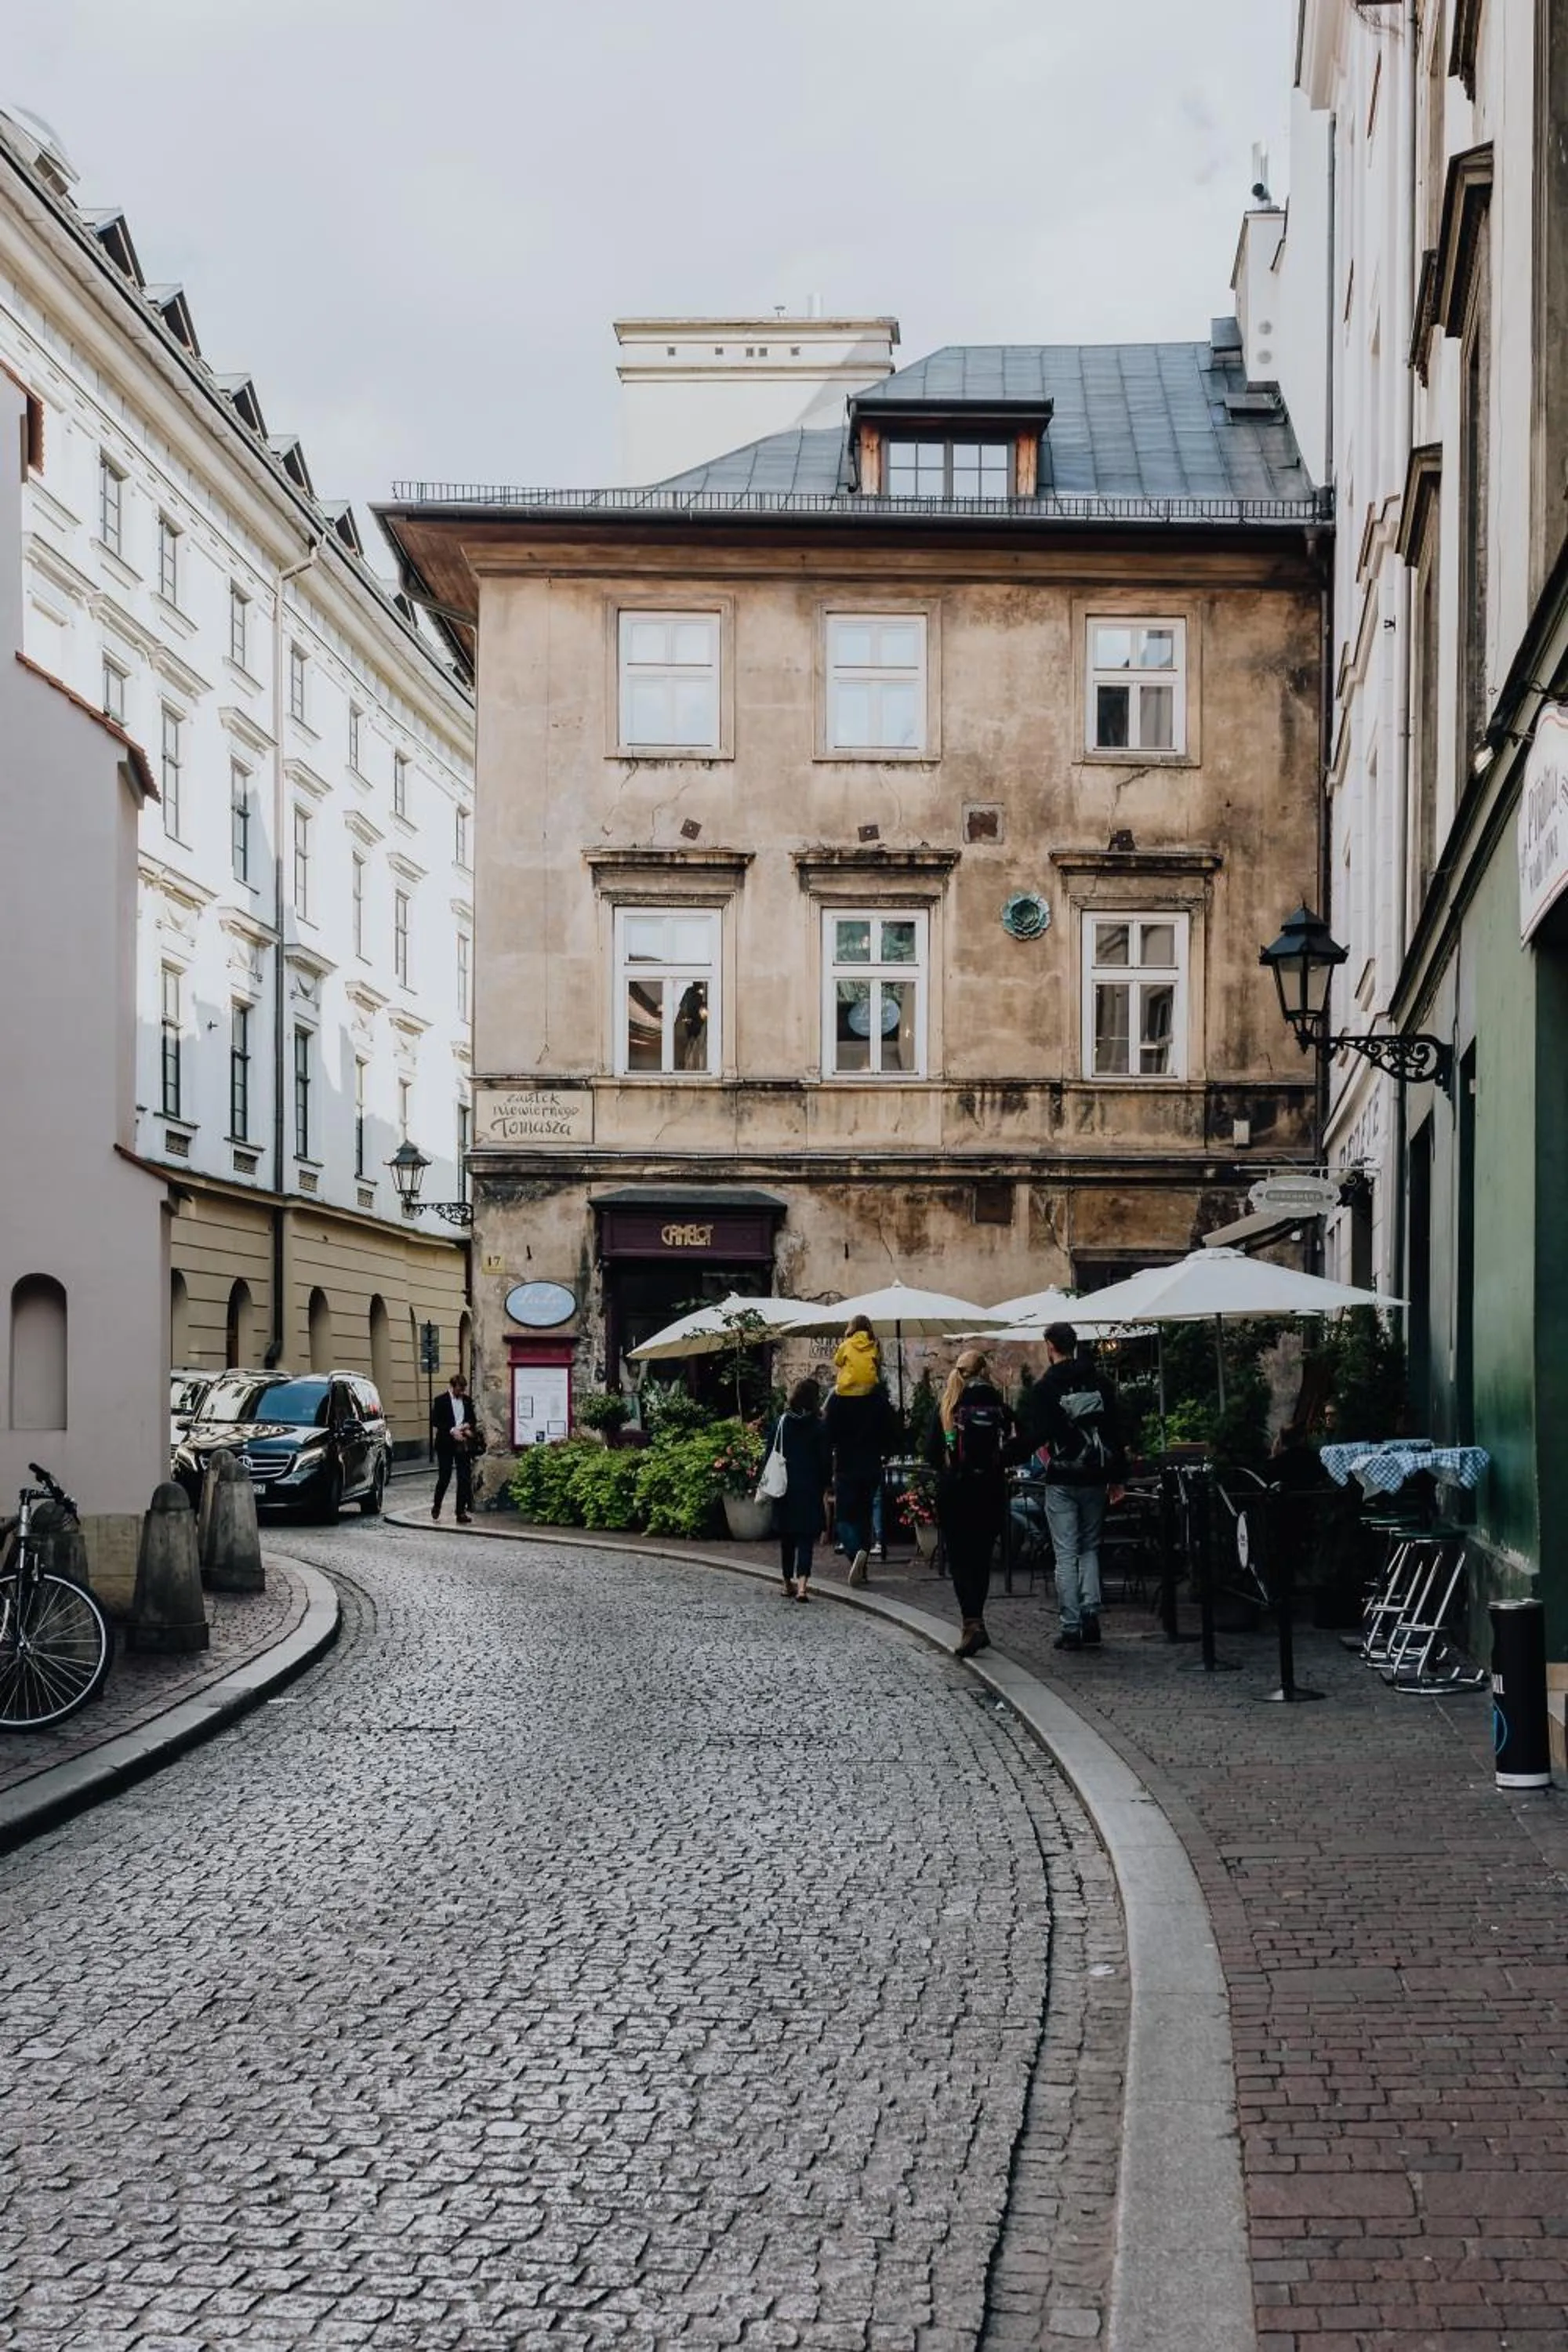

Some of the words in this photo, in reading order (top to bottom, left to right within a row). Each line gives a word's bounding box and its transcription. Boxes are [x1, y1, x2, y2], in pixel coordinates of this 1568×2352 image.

[490, 1116, 572, 1138] Tomasza
[661, 1224, 714, 1246] CAMELOT
[488, 1255, 501, 1267] 17
